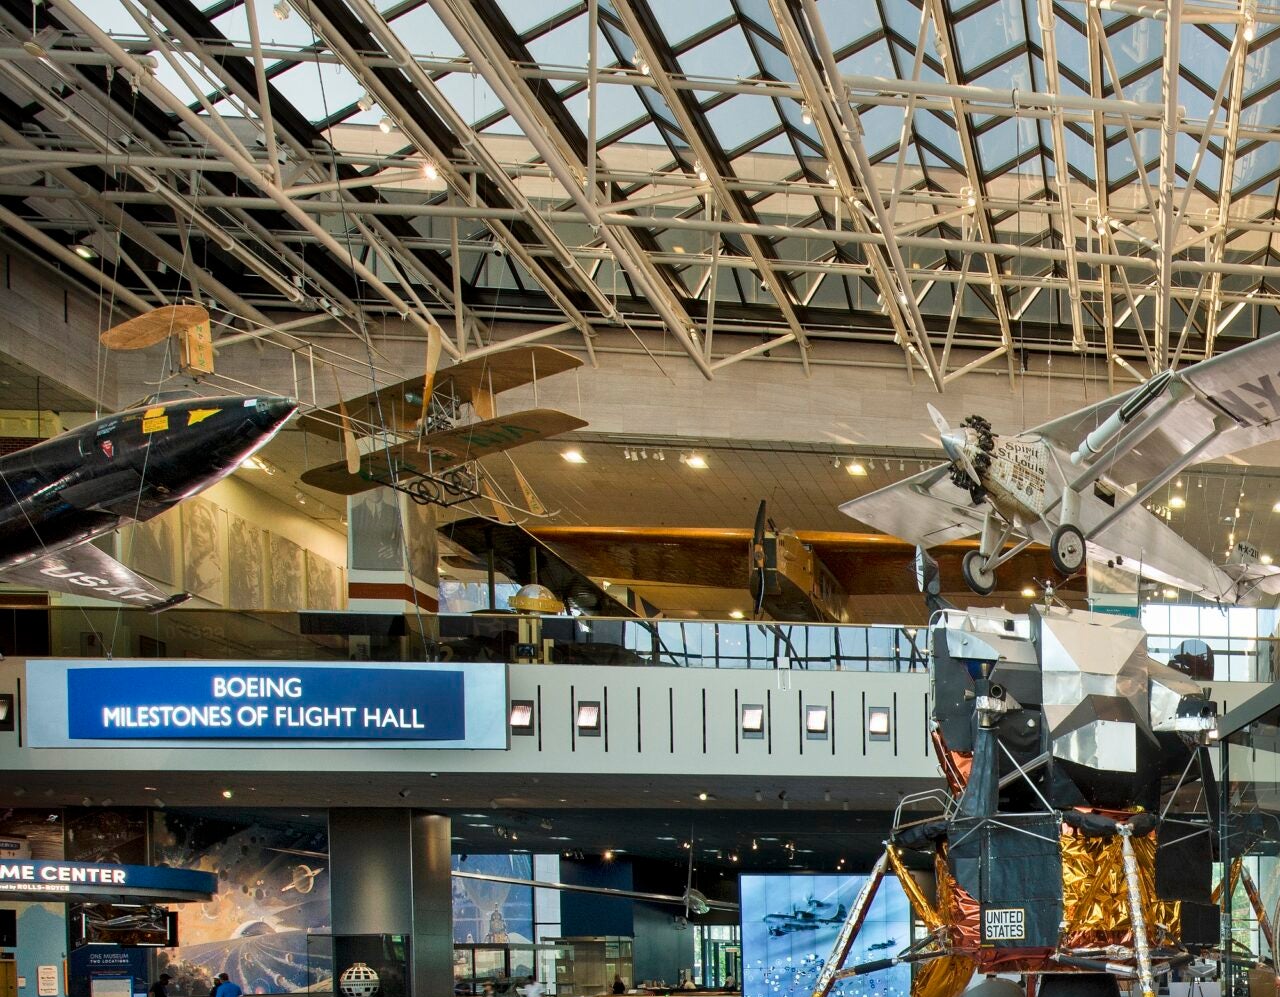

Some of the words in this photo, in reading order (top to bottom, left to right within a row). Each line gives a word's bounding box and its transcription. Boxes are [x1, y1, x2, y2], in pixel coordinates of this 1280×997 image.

[1005, 442, 1039, 458] Spirit
[1015, 454, 1044, 475] Louis
[1238, 543, 1259, 559] N-X-211
[40, 565, 168, 608] USAF
[214, 678, 302, 698] BOEING
[104, 706, 232, 727] MILESTONES
[237, 706, 268, 727] OF
[276, 707, 356, 727] FLIGHT
[364, 708, 424, 728] HALL
[41, 866, 125, 883] CENTER
[987, 911, 1023, 923] UNITED
[987, 925, 1023, 937] STATES
